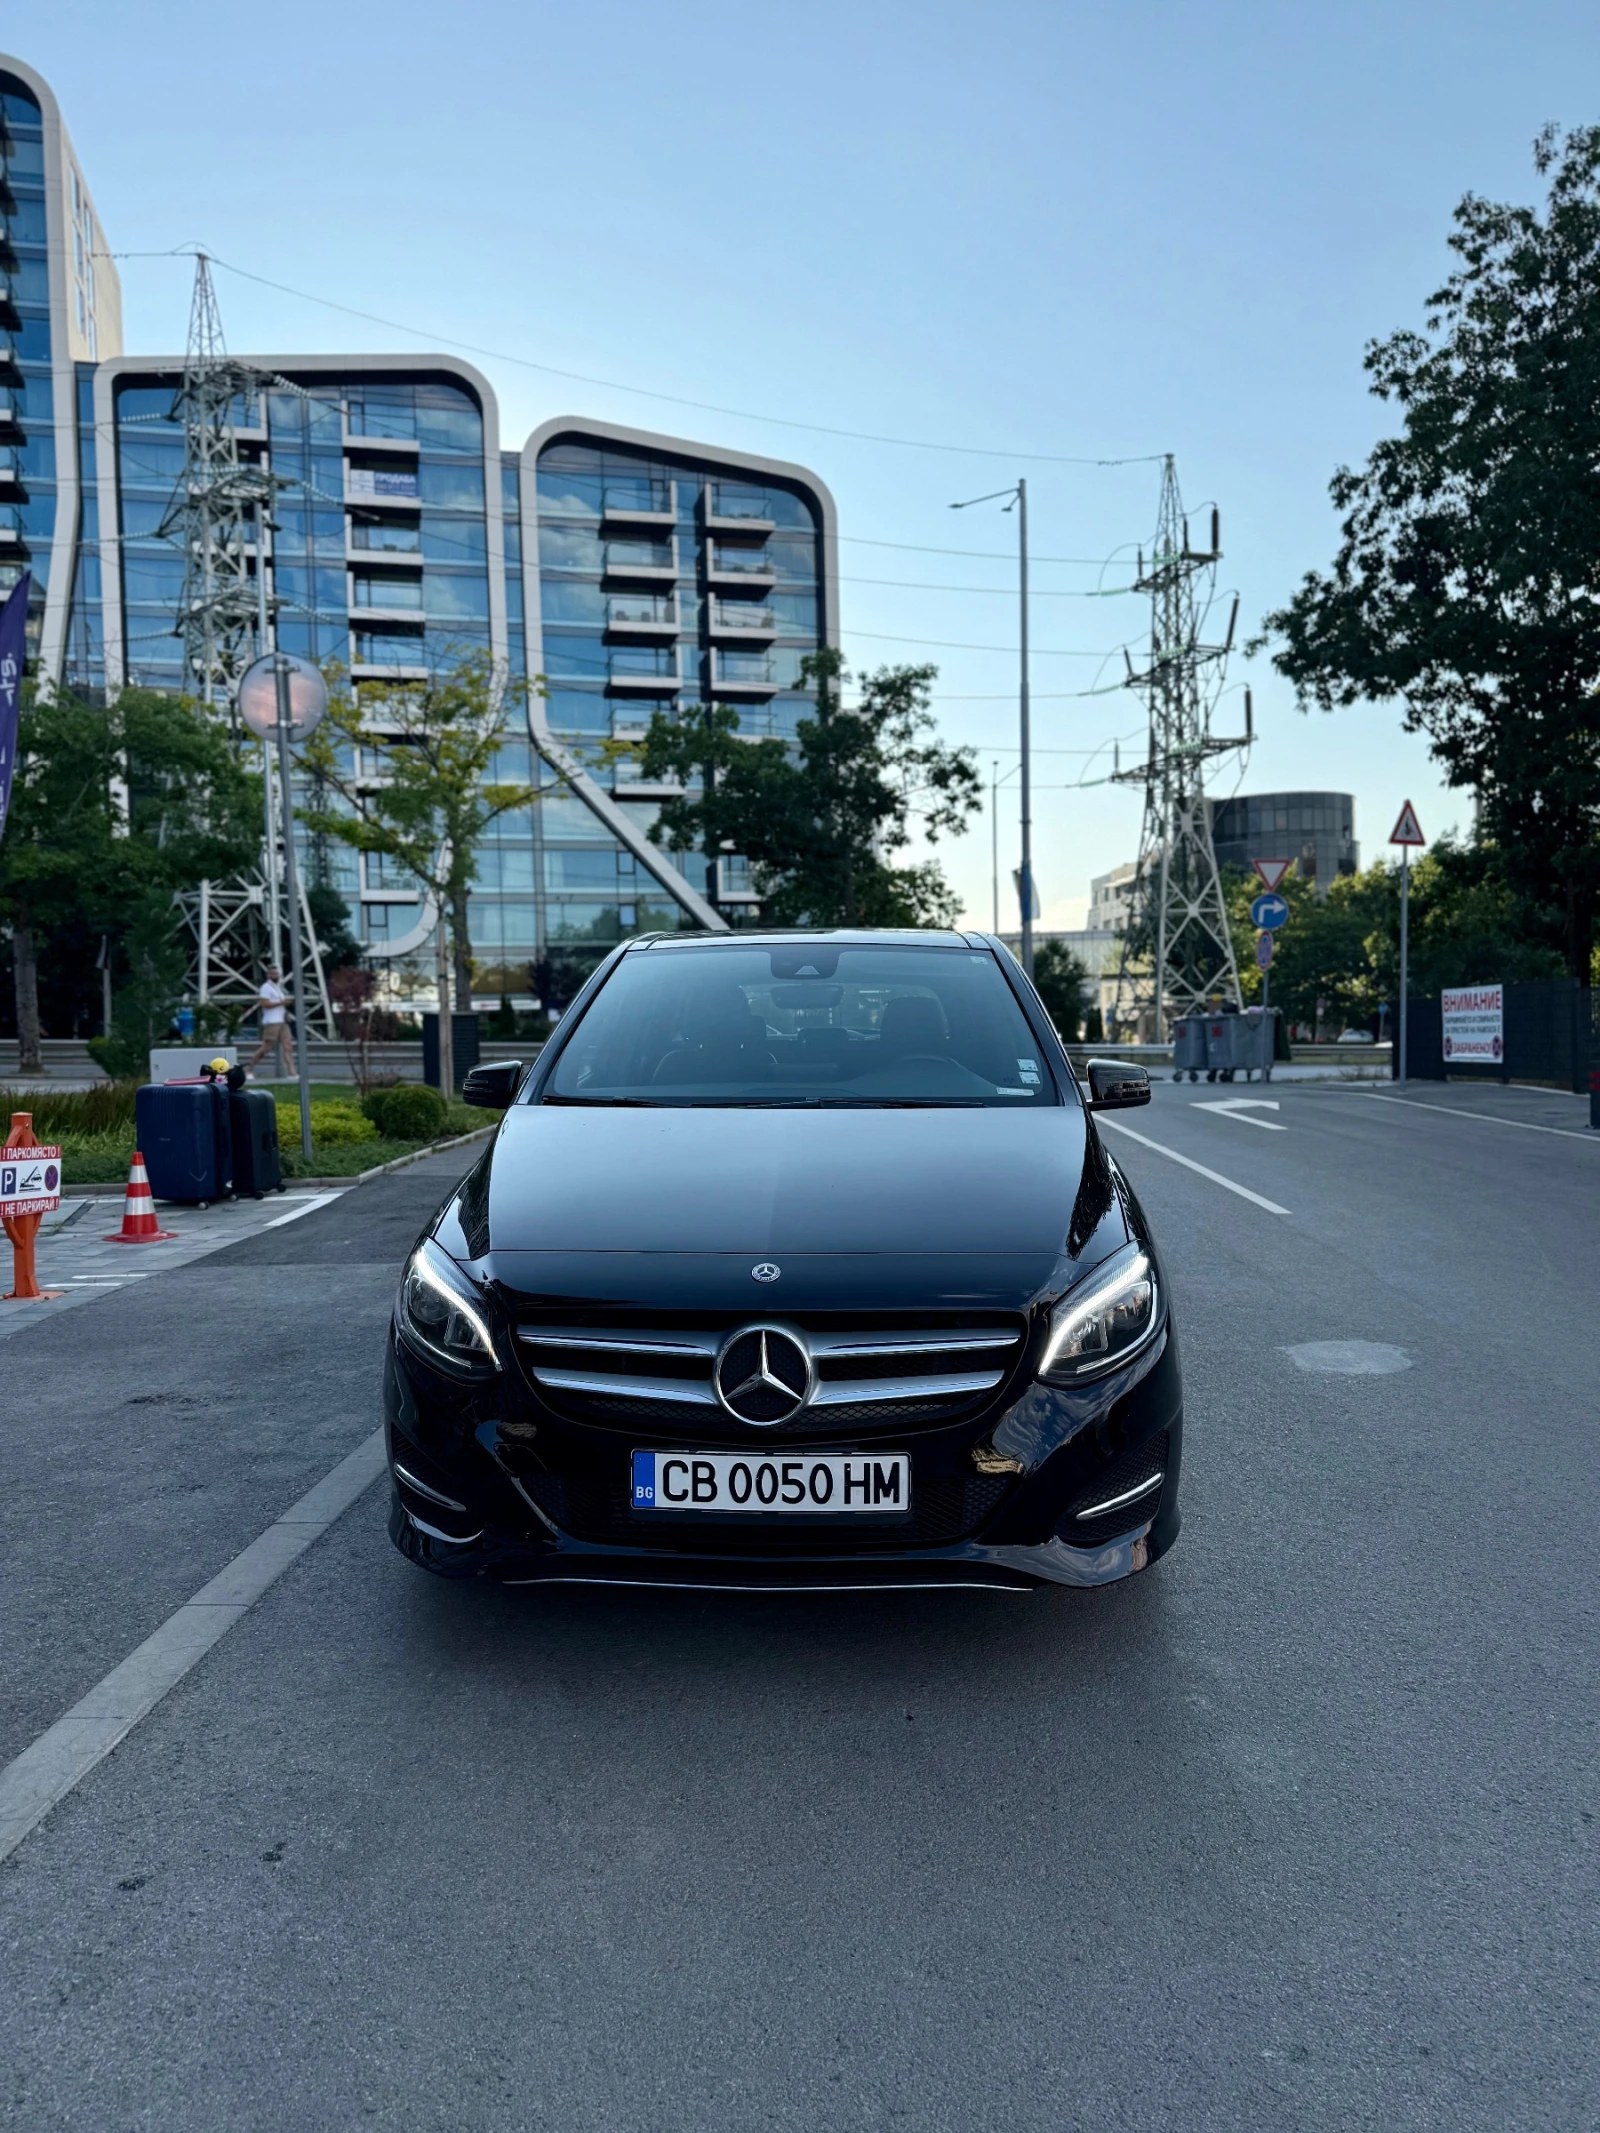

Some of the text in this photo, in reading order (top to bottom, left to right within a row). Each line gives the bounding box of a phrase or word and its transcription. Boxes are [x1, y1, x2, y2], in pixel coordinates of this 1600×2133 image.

[1444, 991, 1500, 1012] ВНИМАНИЕ
[7, 1147, 56, 1160] ПАРКОМЯСТО
[5, 1202, 15, 1216] НЕ
[17, 1197, 55, 1213] ПАРКИРАЙ
[662, 1460, 901, 1504] CB 0050 HM
[635, 1486, 653, 1499] BG
